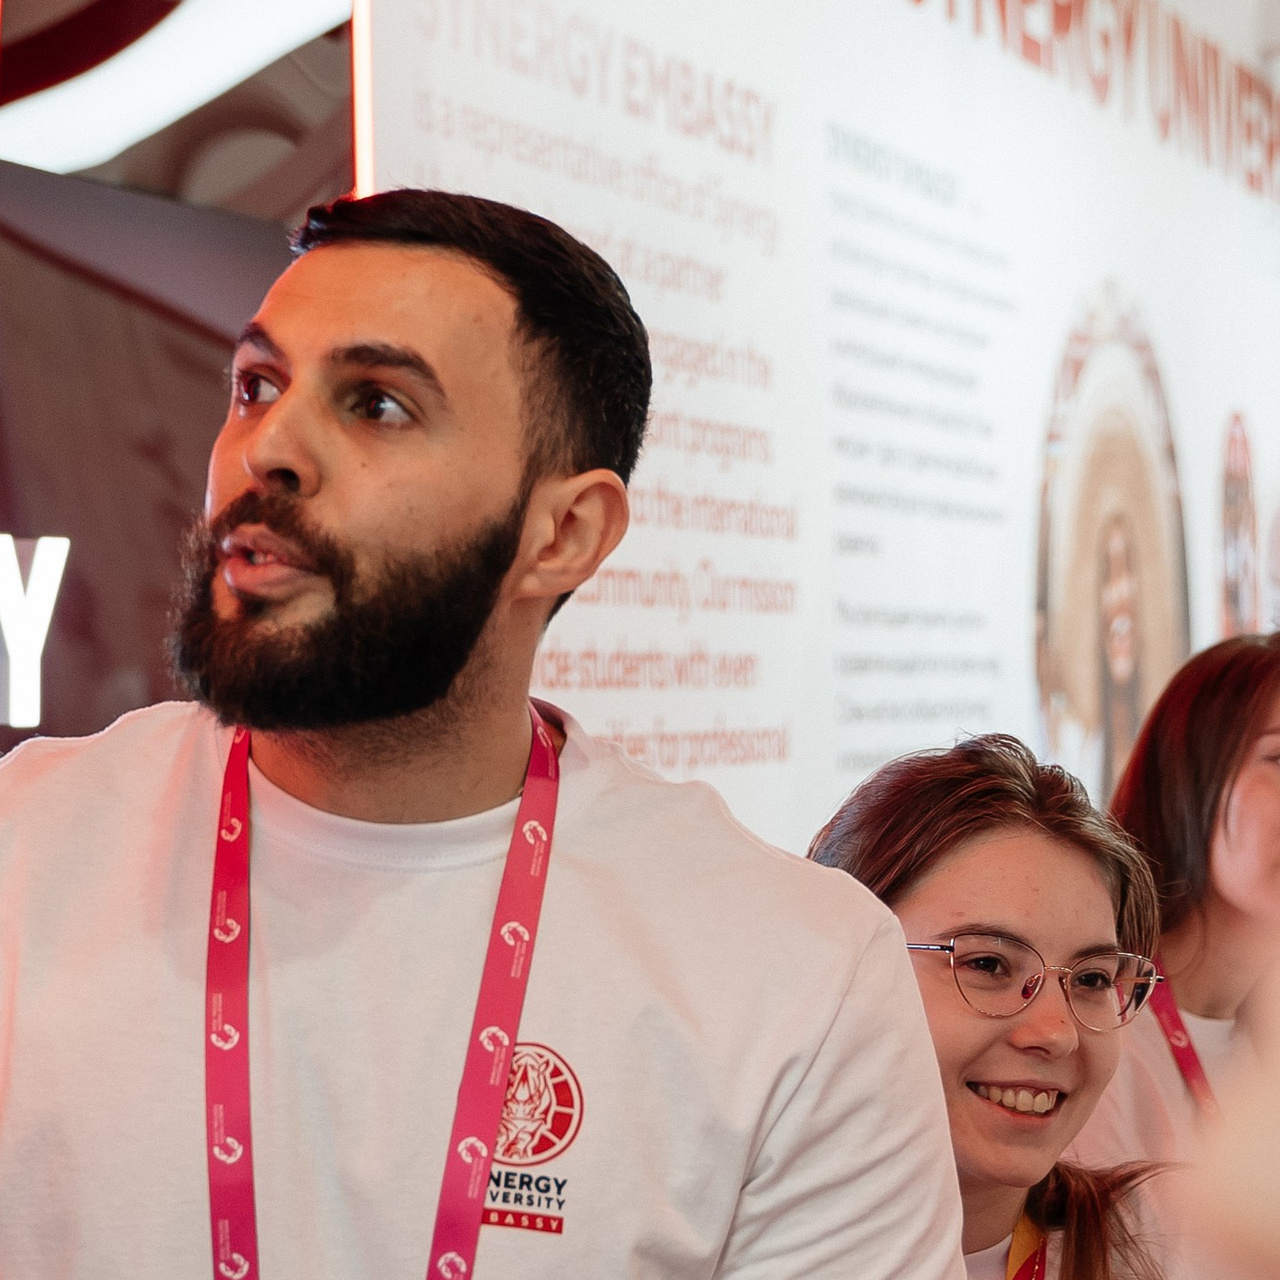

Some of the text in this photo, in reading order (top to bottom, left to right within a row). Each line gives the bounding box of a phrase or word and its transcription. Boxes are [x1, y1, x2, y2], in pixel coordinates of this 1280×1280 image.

[623, 35, 778, 166] EMBASSY
[487, 1169, 568, 1197] NERGY
[489, 1190, 567, 1211] VERSITY
[488, 1210, 560, 1232] BASSY
